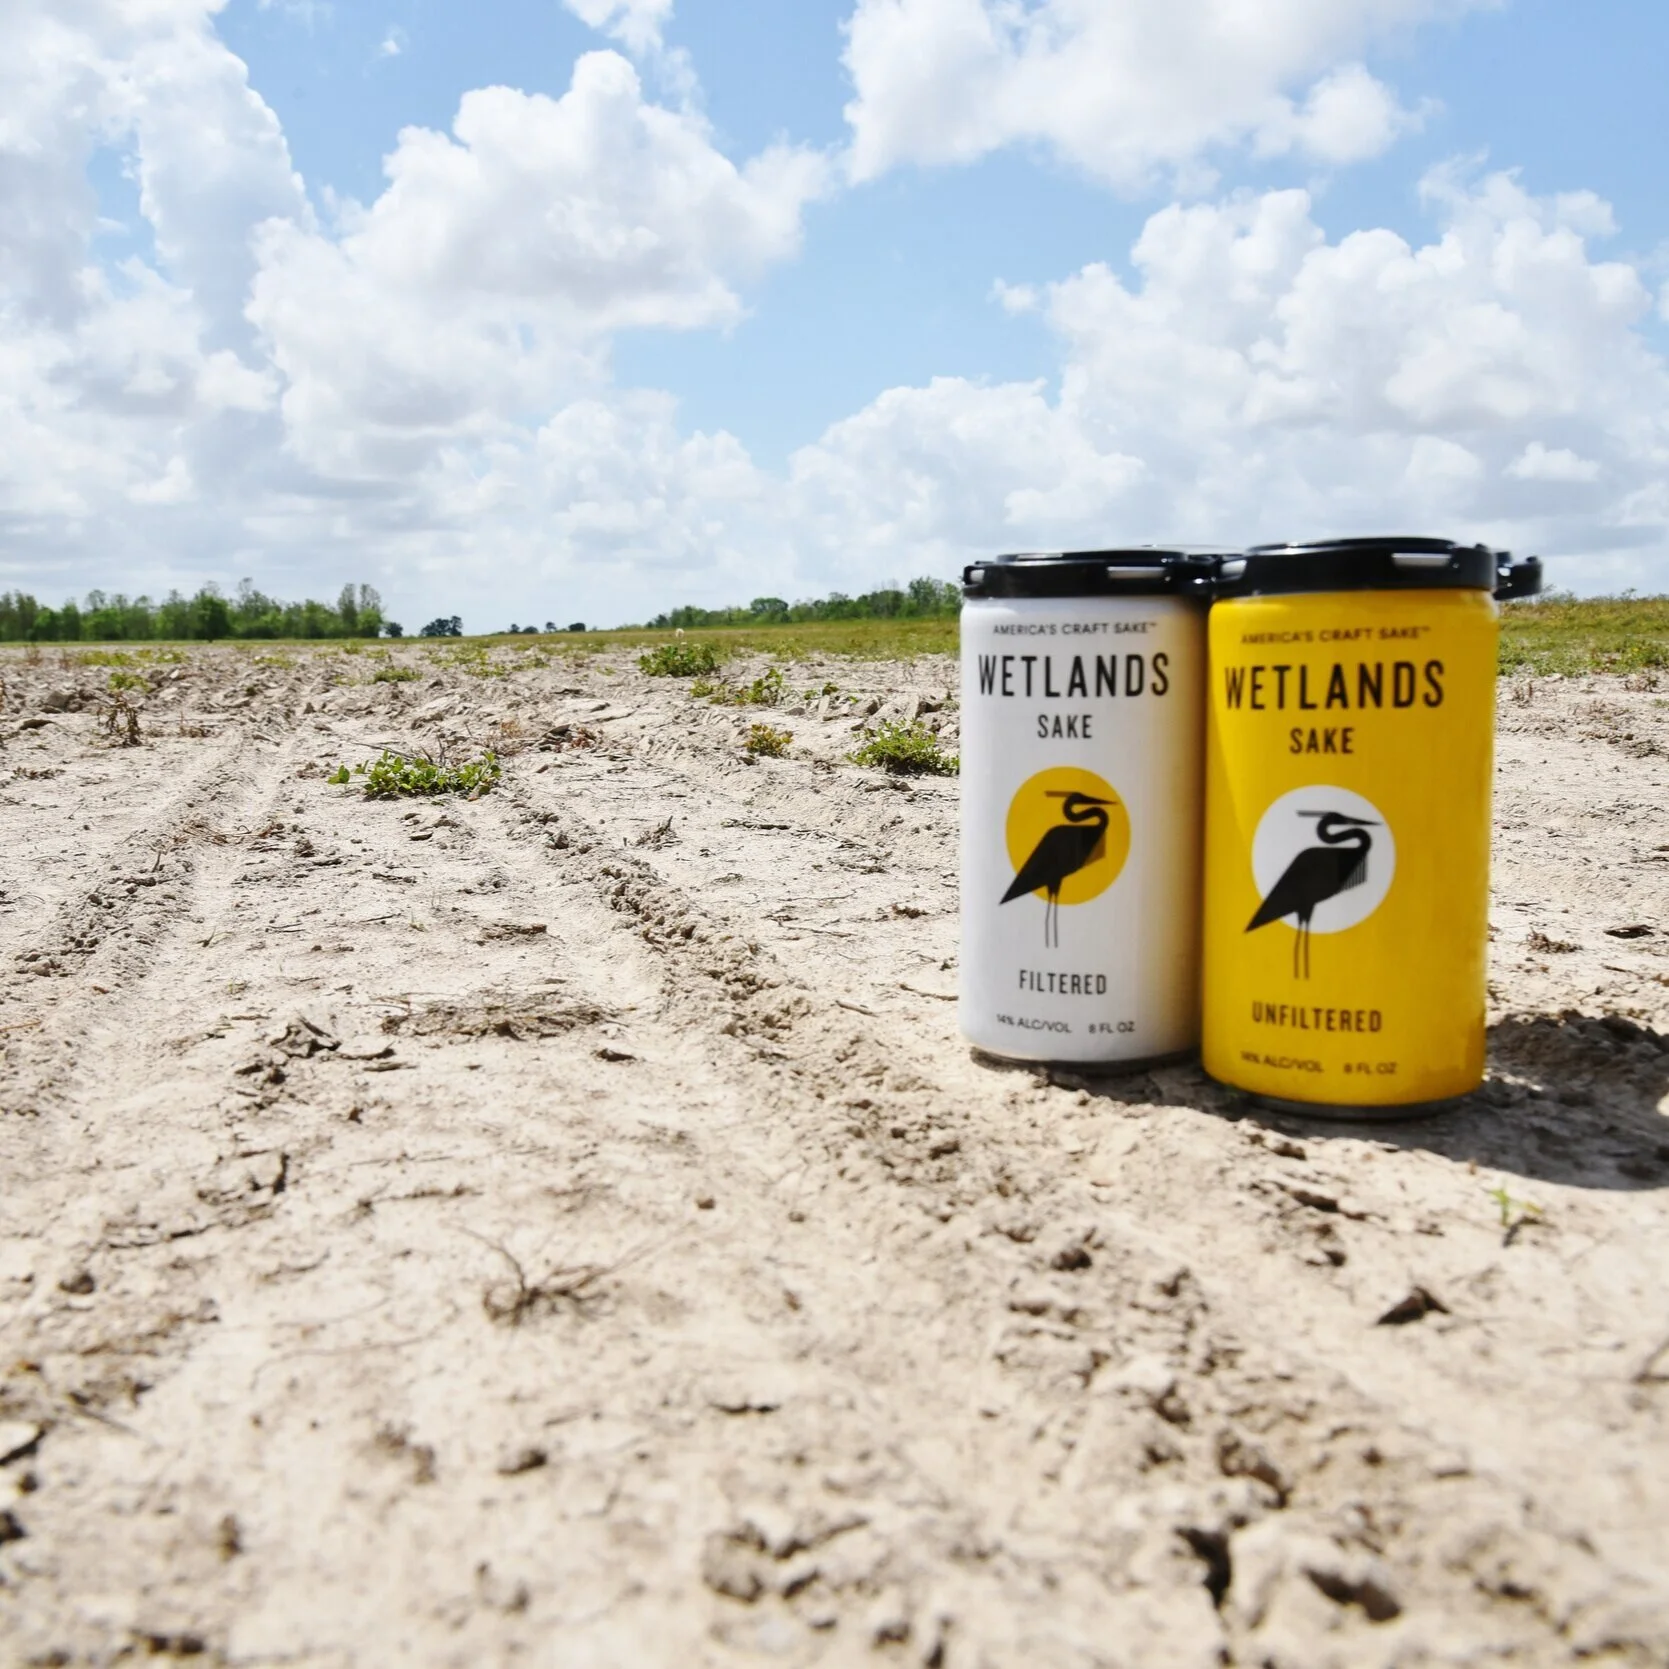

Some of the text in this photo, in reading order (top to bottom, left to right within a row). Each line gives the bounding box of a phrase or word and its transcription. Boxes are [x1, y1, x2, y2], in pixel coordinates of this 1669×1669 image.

[993, 623, 1057, 635] AMERICA'S
[1062, 622, 1108, 635] CRAFT
[1241, 630, 1314, 645] AMERICA'S
[1319, 628, 1373, 643] CRAFT
[978, 652, 1169, 698] WETLANDS
[1225, 659, 1445, 710] WETLANDS
[1037, 714, 1093, 739] SAKE
[1290, 727, 1355, 755] SAKE
[1019, 969, 1107, 995] FILTERED
[1016, 1017, 1072, 1034] ALC/VOL
[1088, 1023, 1096, 1034] 8
[1099, 1022, 1114, 1034] FL
[1116, 1021, 1136, 1033] OZ
[1252, 1000, 1383, 1033] UNFILTERED
[1262, 1054, 1324, 1073] ALC/VOL
[1356, 1062, 1371, 1075] FL
[1376, 1062, 1398, 1075] OZ
